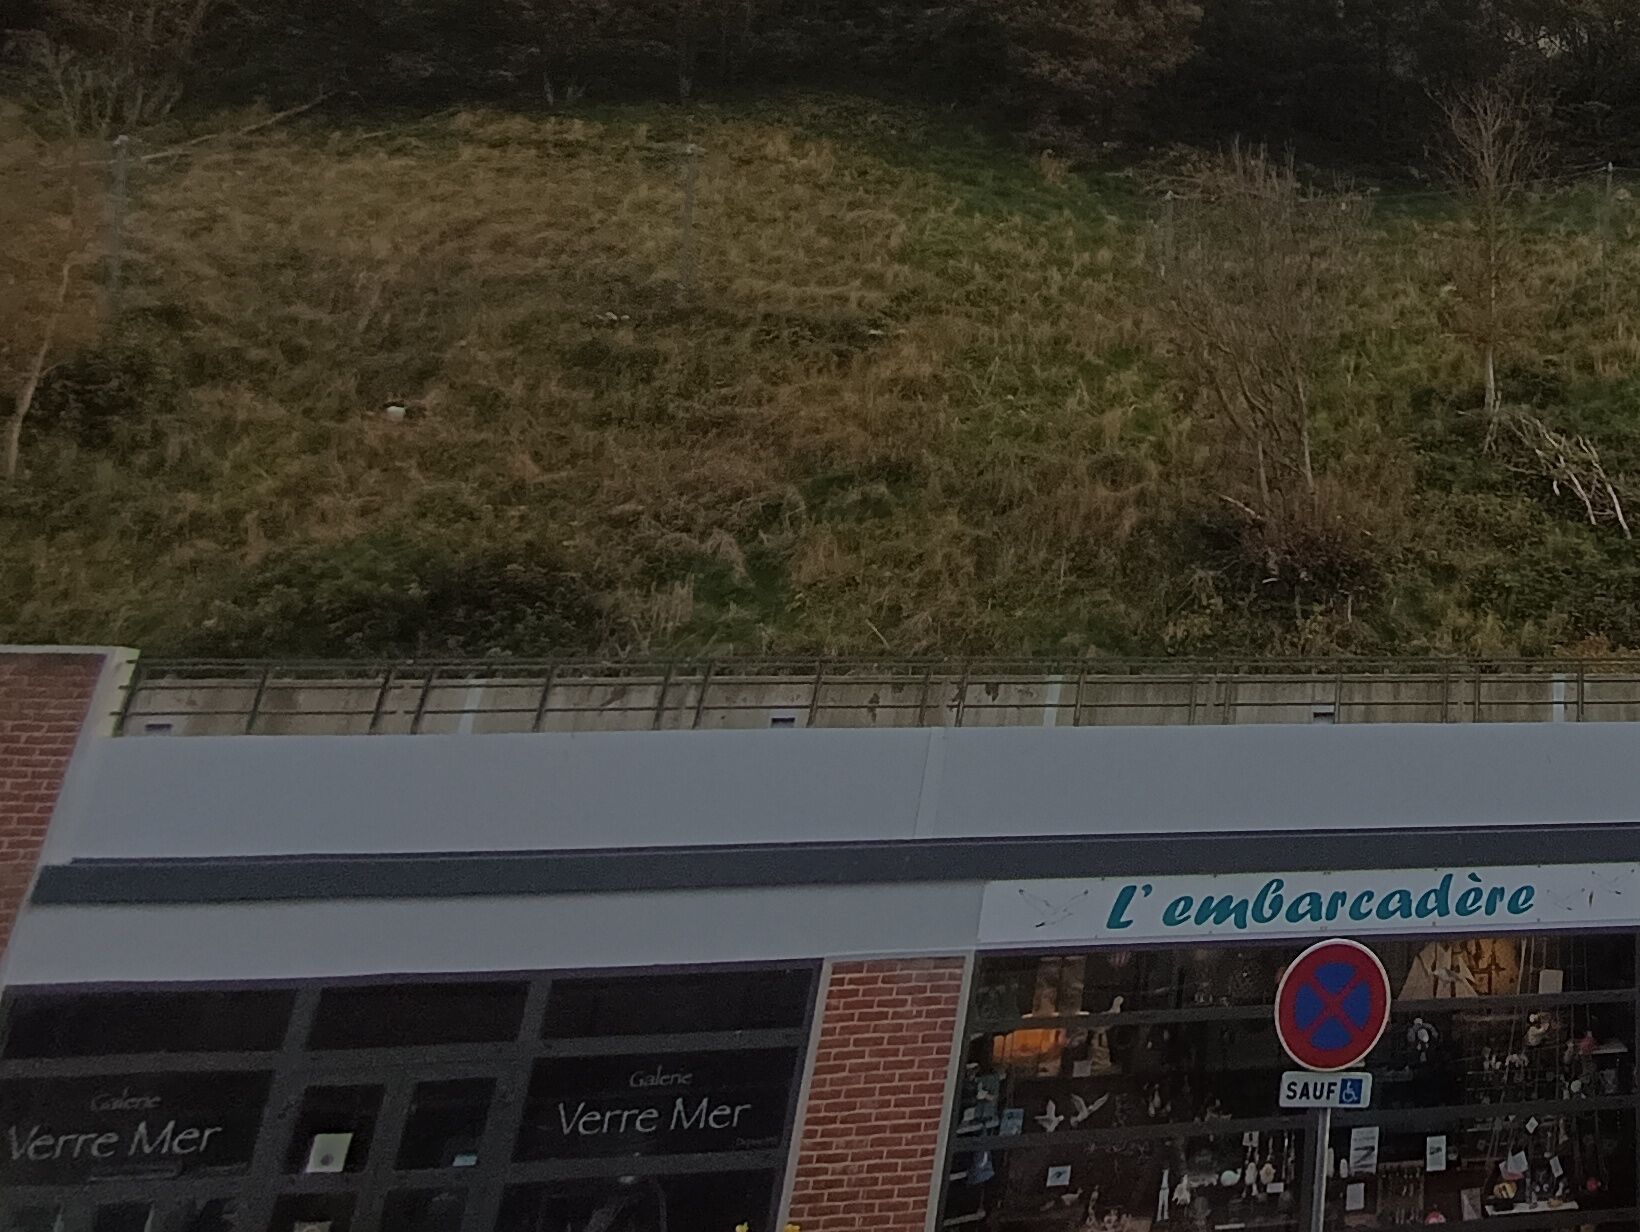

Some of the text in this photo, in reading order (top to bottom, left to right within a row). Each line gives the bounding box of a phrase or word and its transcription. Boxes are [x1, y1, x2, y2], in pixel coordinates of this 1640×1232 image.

[629, 1065, 693, 1088] Galerie
[1286, 1081, 1337, 1100] SAUF
[558, 1096, 752, 1136] Verre Mer
[7, 1120, 223, 1161] Verre Mer
